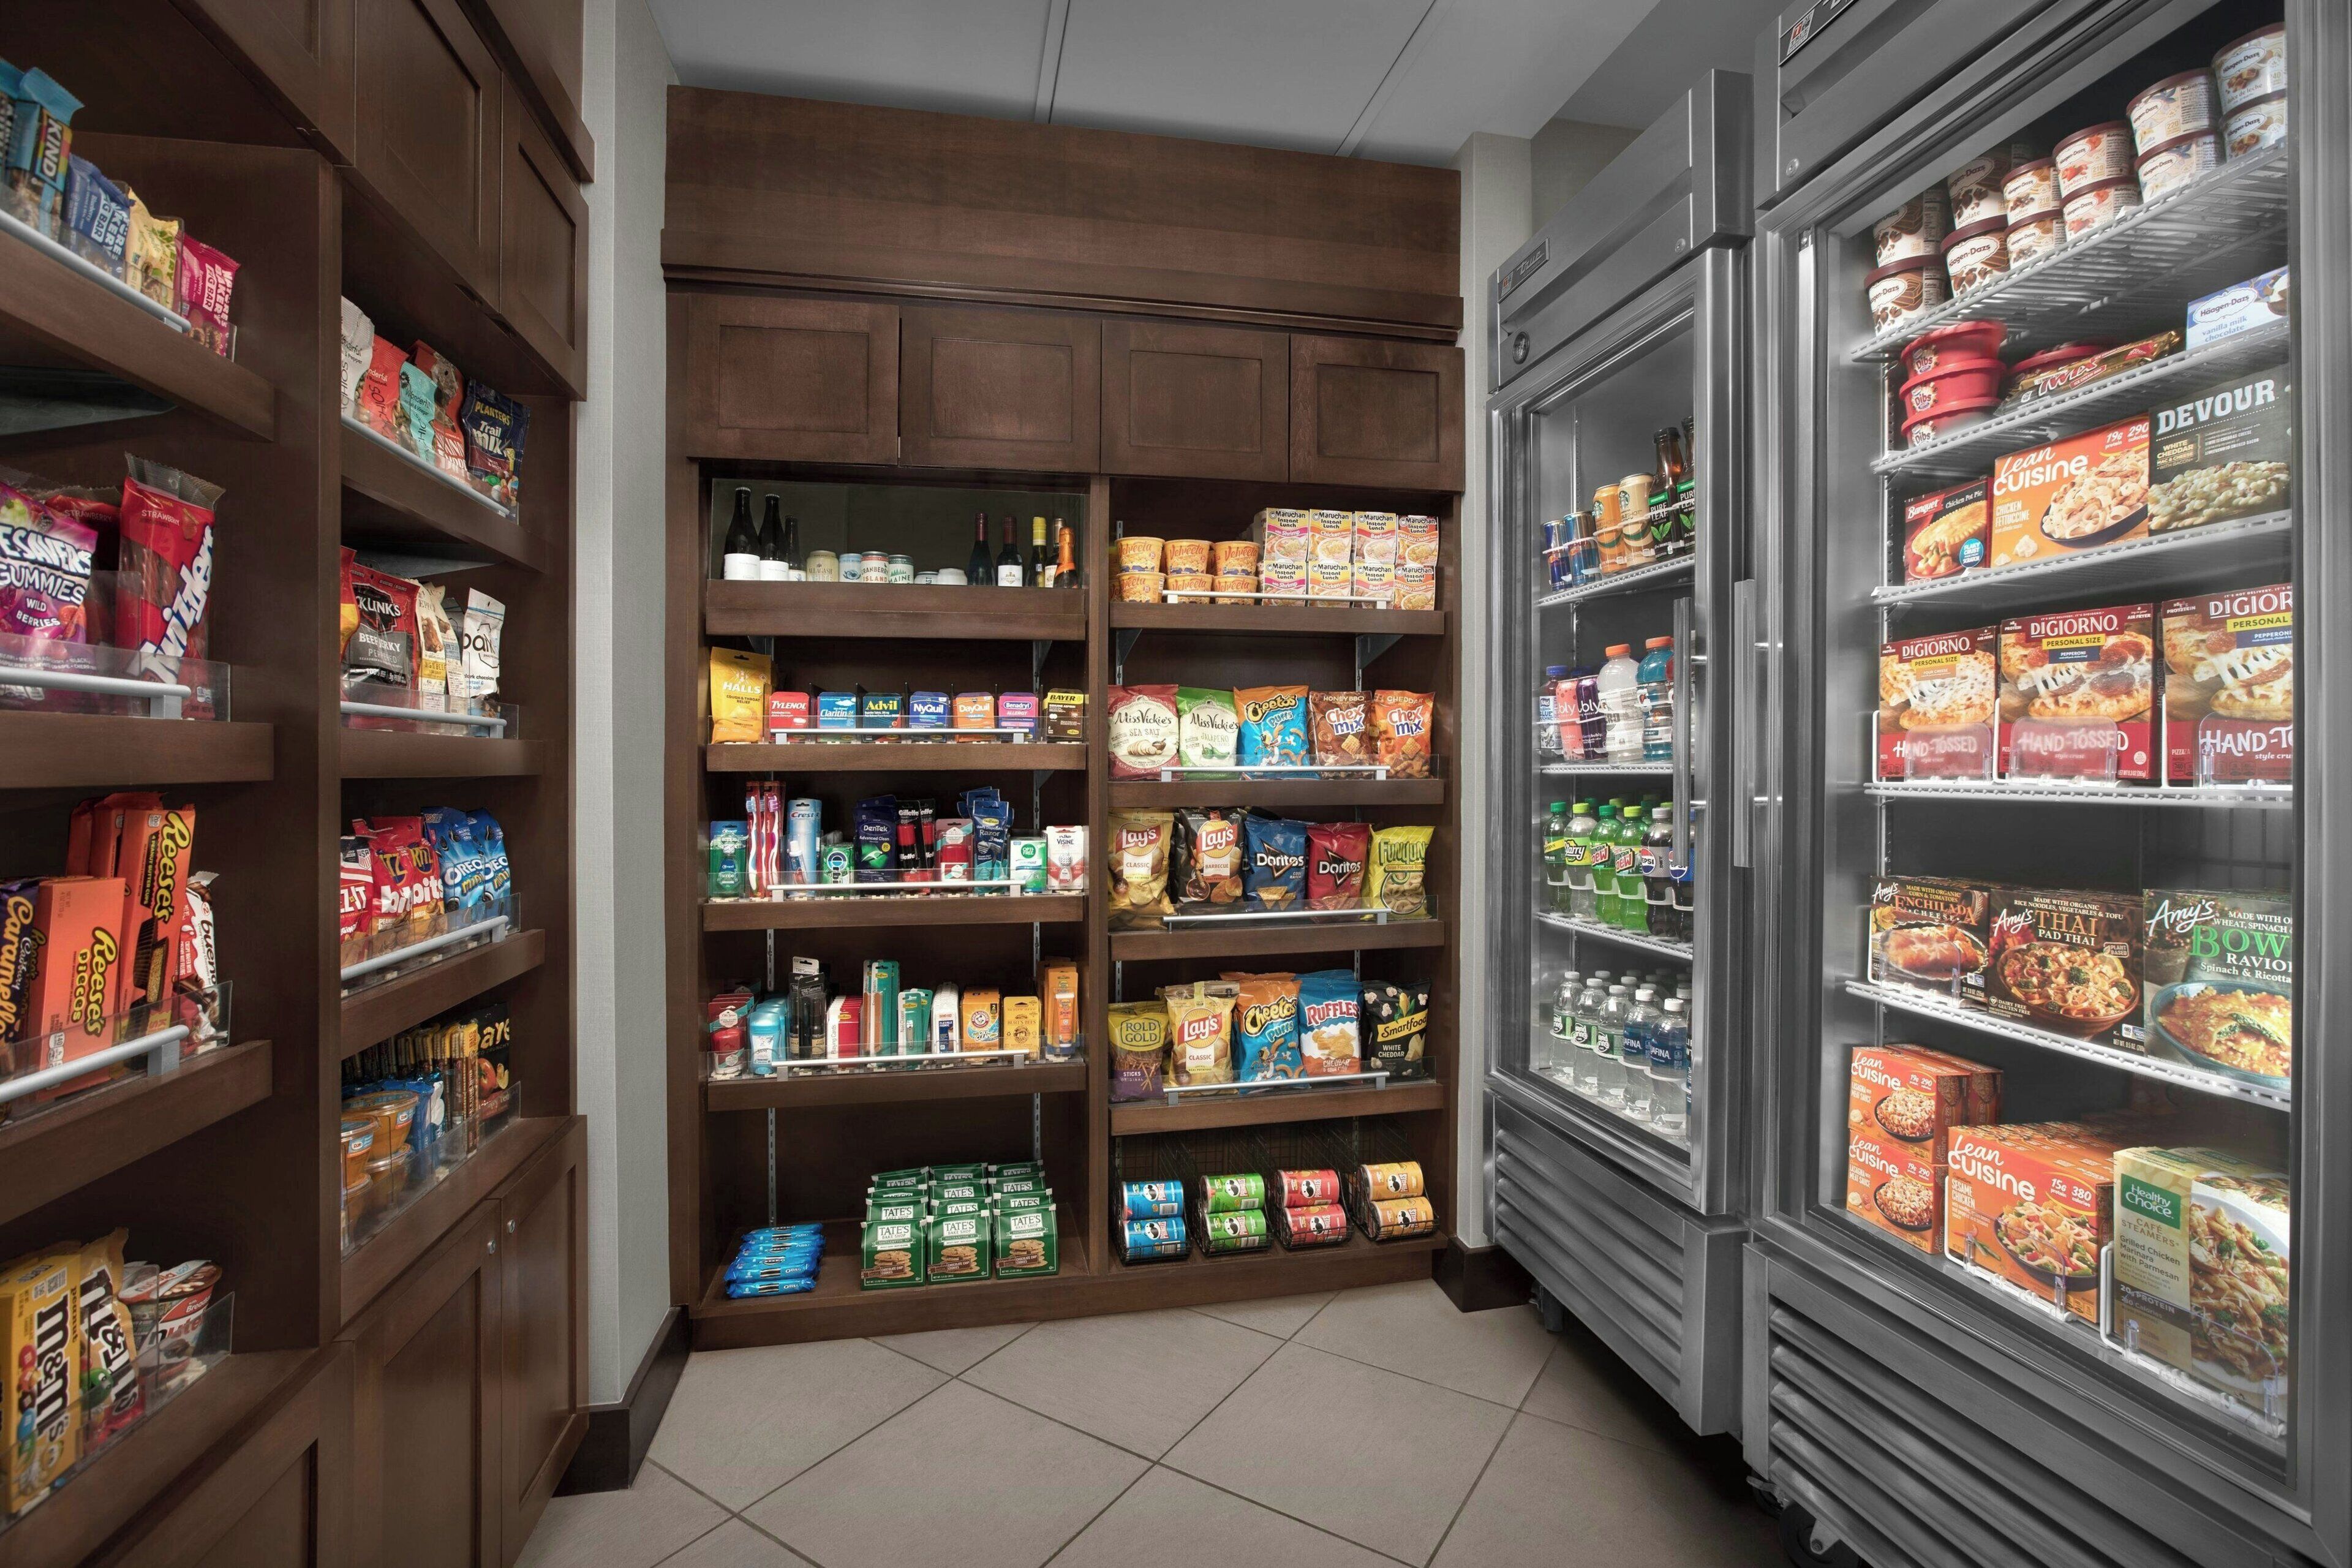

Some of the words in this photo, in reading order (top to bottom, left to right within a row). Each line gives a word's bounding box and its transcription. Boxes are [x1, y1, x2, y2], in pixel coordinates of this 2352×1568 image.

[42, 118, 62, 178] KIND
[2200, 295, 2249, 317] Häagen-Dazs
[2202, 322, 2228, 336] vanilla
[2230, 315, 2247, 326] milk
[2206, 325, 2245, 342] chocolate
[1916, 356, 1933, 366] Dibs
[474, 401, 511, 426] PLANTERS
[2157, 379, 2275, 435] DEVOUR
[480, 421, 502, 436] Trail
[2127, 423, 2149, 437] 290
[473, 428, 503, 454] mix
[2163, 439, 2187, 451] WHITE
[2157, 445, 2193, 459] CHEDDAR
[2000, 447, 2056, 479] Lean
[1907, 499, 1940, 519] Banquet
[1945, 495, 1964, 509] Chicken
[1996, 500, 2022, 516] CHICKEN
[141, 510, 179, 526] STRAWBERRY
[1996, 510, 2030, 524] FETTUCCINE
[1170, 544, 1204, 560] Velveeta
[0, 566, 86, 605] GUMMIES
[26, 598, 47, 611] WILD
[16, 611, 60, 627] BERRIES
[359, 632, 380, 644] BEEF
[2046, 638, 2084, 647] PERSONAL
[723, 682, 761, 695] HALLS
[771, 701, 806, 710] TYLENOL
[865, 701, 897, 710] Advil
[959, 703, 990, 713] DayQuil
[1387, 696, 1423, 704] CHEDDAR
[914, 704, 944, 714] NyQuil
[1326, 704, 1365, 724] Chex
[1334, 716, 1365, 735] mix
[1201, 826, 1235, 851] Lay's
[154, 812, 190, 923] Reese's
[1257, 853, 1304, 867] Doritos
[1319, 861, 1361, 874] Doritos
[145, 865, 154, 888] BUTTER
[444, 859, 483, 886] OREO
[142, 889, 151, 906] CUPS
[1872, 883, 1898, 904] Amy's
[1913, 909, 1954, 921] CHEESE
[2028, 902, 2057, 911] NOODLES,
[2059, 906, 2097, 916] VEGETABLES
[1992, 908, 2034, 937] Amy's
[2035, 910, 2098, 937] THAI
[2146, 899, 2215, 937] Amy's
[2038, 929, 2061, 940] PAD
[2064, 933, 2095, 946] THAI
[200, 920, 216, 984] bueno
[2200, 962, 2238, 975] Spinach
[2255, 970, 2291, 984] Ricotta
[85, 927, 118, 1038] Reese's
[1244, 995, 1297, 1037] Cheetos
[1306, 1000, 1360, 1026] RUFFLES
[1126, 1022, 1156, 1031] ROLD
[1184, 1016, 1219, 1041] Lay's
[1381, 1016, 1427, 1038] Smartfood
[1125, 1033, 1157, 1042] GOLD
[1948, 1134, 2004, 1166] Lean
[1951, 1179, 1972, 1193] SESAME
[2072, 1186, 2092, 1201] 380
[1951, 1190, 1975, 1210] CHICKEN
[2132, 1184, 2171, 1207] Healthy
[884, 1207, 911, 1218] TATE'S
[2125, 1192, 2172, 1218] Choice
[944, 1221, 974, 1232] TATE'S
[1012, 1215, 1041, 1226] TATE'S
[2136, 1218, 2163, 1235] CAFÉ
[880, 1225, 910, 1236] TATE'S
[2121, 1219, 2175, 1247] STEAMERS
[2120, 1235, 2145, 1251] Grilled
[2147, 1247, 2180, 1265] Chicken
[2120, 1243, 2154, 1263] Marinara
[2120, 1253, 2137, 1264] with
[2139, 1261, 2179, 1281] Parmesan
